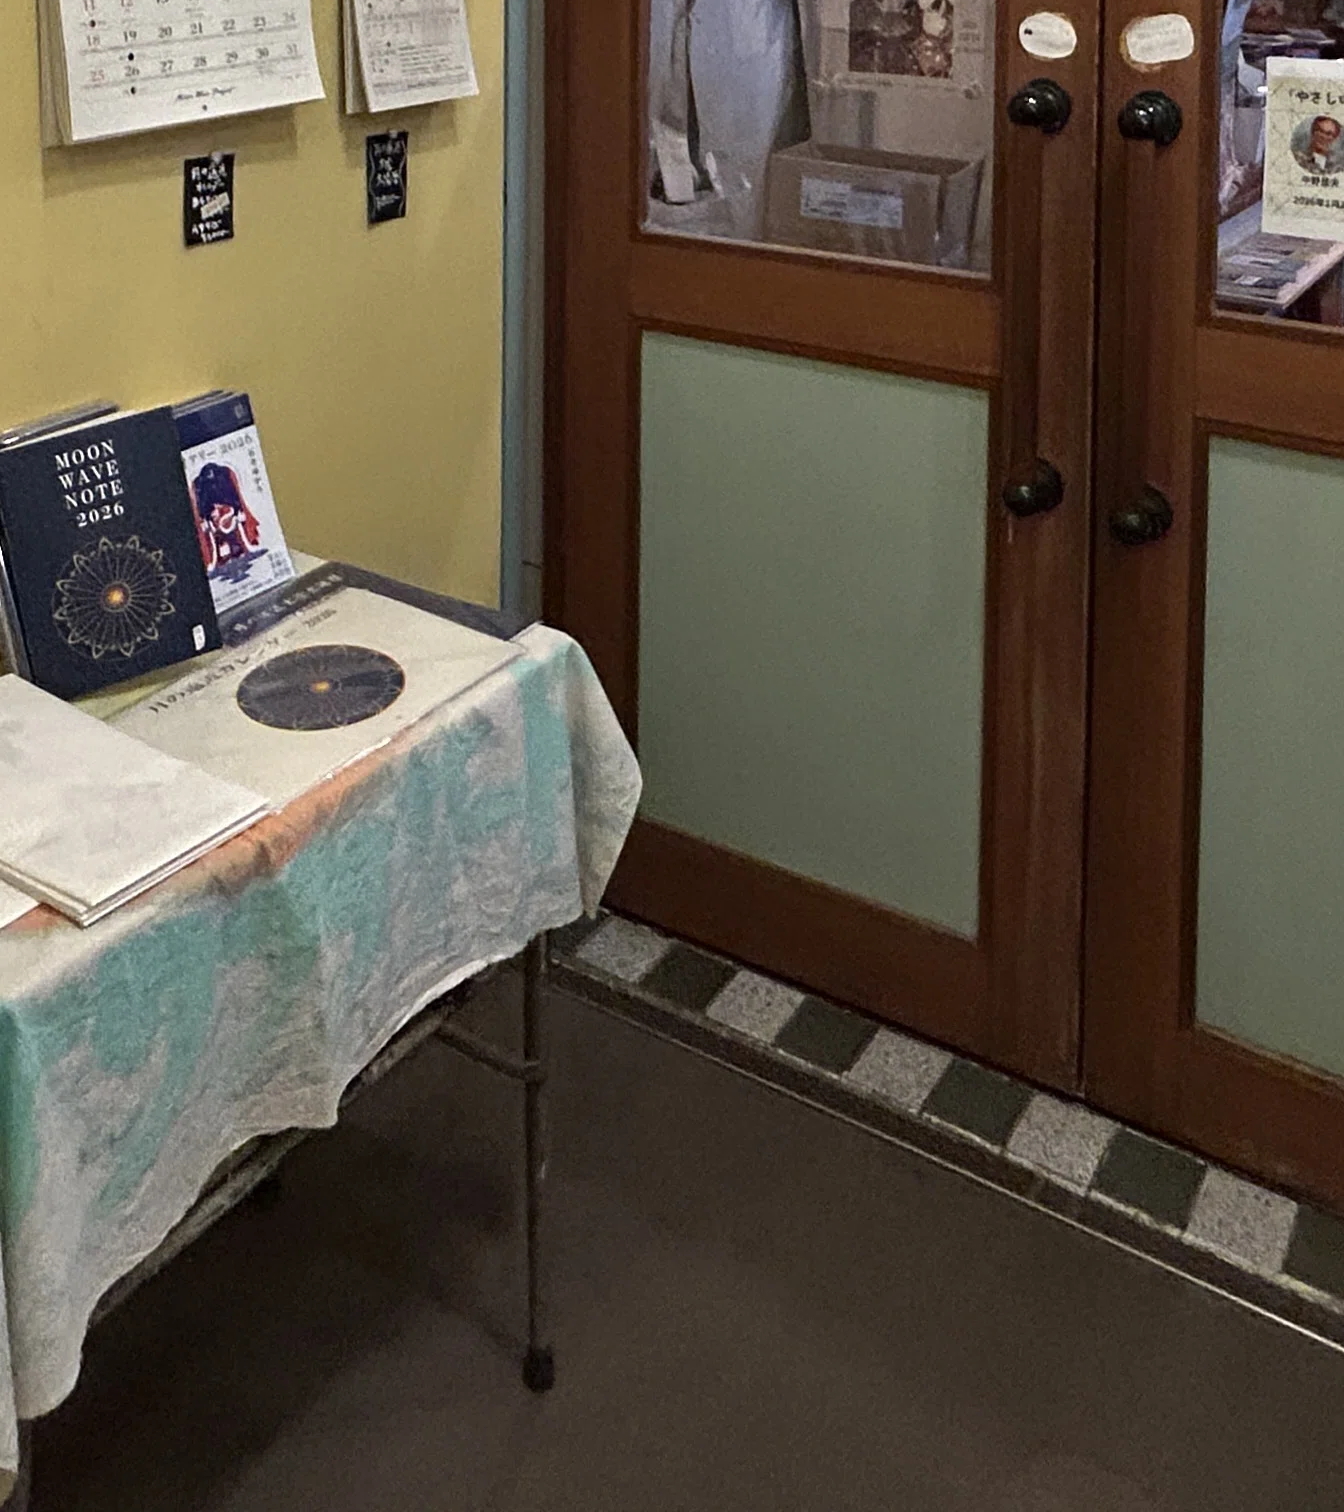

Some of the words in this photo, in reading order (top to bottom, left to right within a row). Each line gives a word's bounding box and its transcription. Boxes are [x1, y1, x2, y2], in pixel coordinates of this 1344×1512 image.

[123, 31, 138, 43] 19
[158, 25, 173, 38] 20
[190, 21, 203, 35] 21
[222, 18, 236, 32] 22
[253, 15, 266, 27] 23
[90, 69, 105, 83] 25
[125, 65, 140, 78] 26
[160, 59, 174, 73] 27
[193, 55, 207, 68] 28
[226, 50, 239, 64] 29
[256, 47, 270, 60] 30
[55, 439, 115, 471] MOON
[59, 459, 119, 489] WAVE
[65, 479, 124, 510] NOTE
[76, 501, 124, 527] 2026
